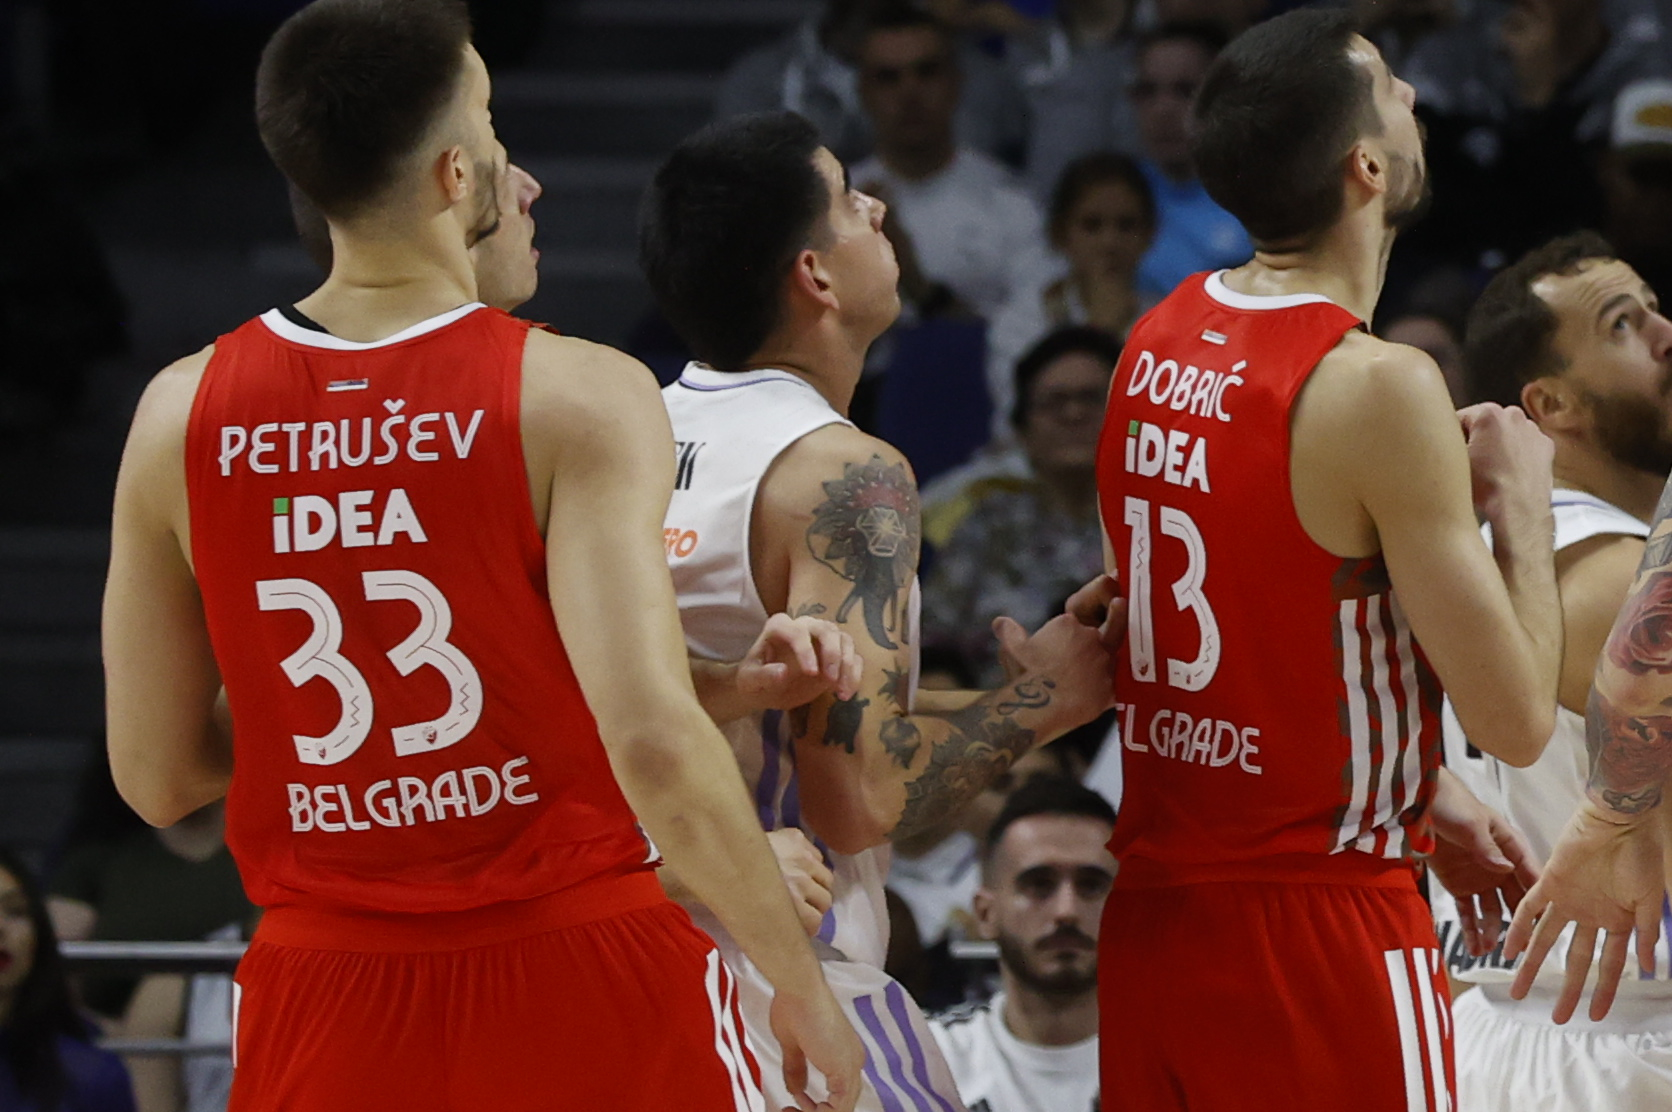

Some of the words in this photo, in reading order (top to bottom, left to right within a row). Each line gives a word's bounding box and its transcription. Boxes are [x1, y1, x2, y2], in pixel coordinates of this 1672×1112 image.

[1126, 350, 1247, 422] DOBRIĆ
[218, 398, 484, 476] PETRUŠEV
[1124, 495, 1221, 692] 13
[255, 570, 484, 765] 33
[1115, 703, 1262, 775] LGRADE
[287, 755, 538, 832] BELGRADE
